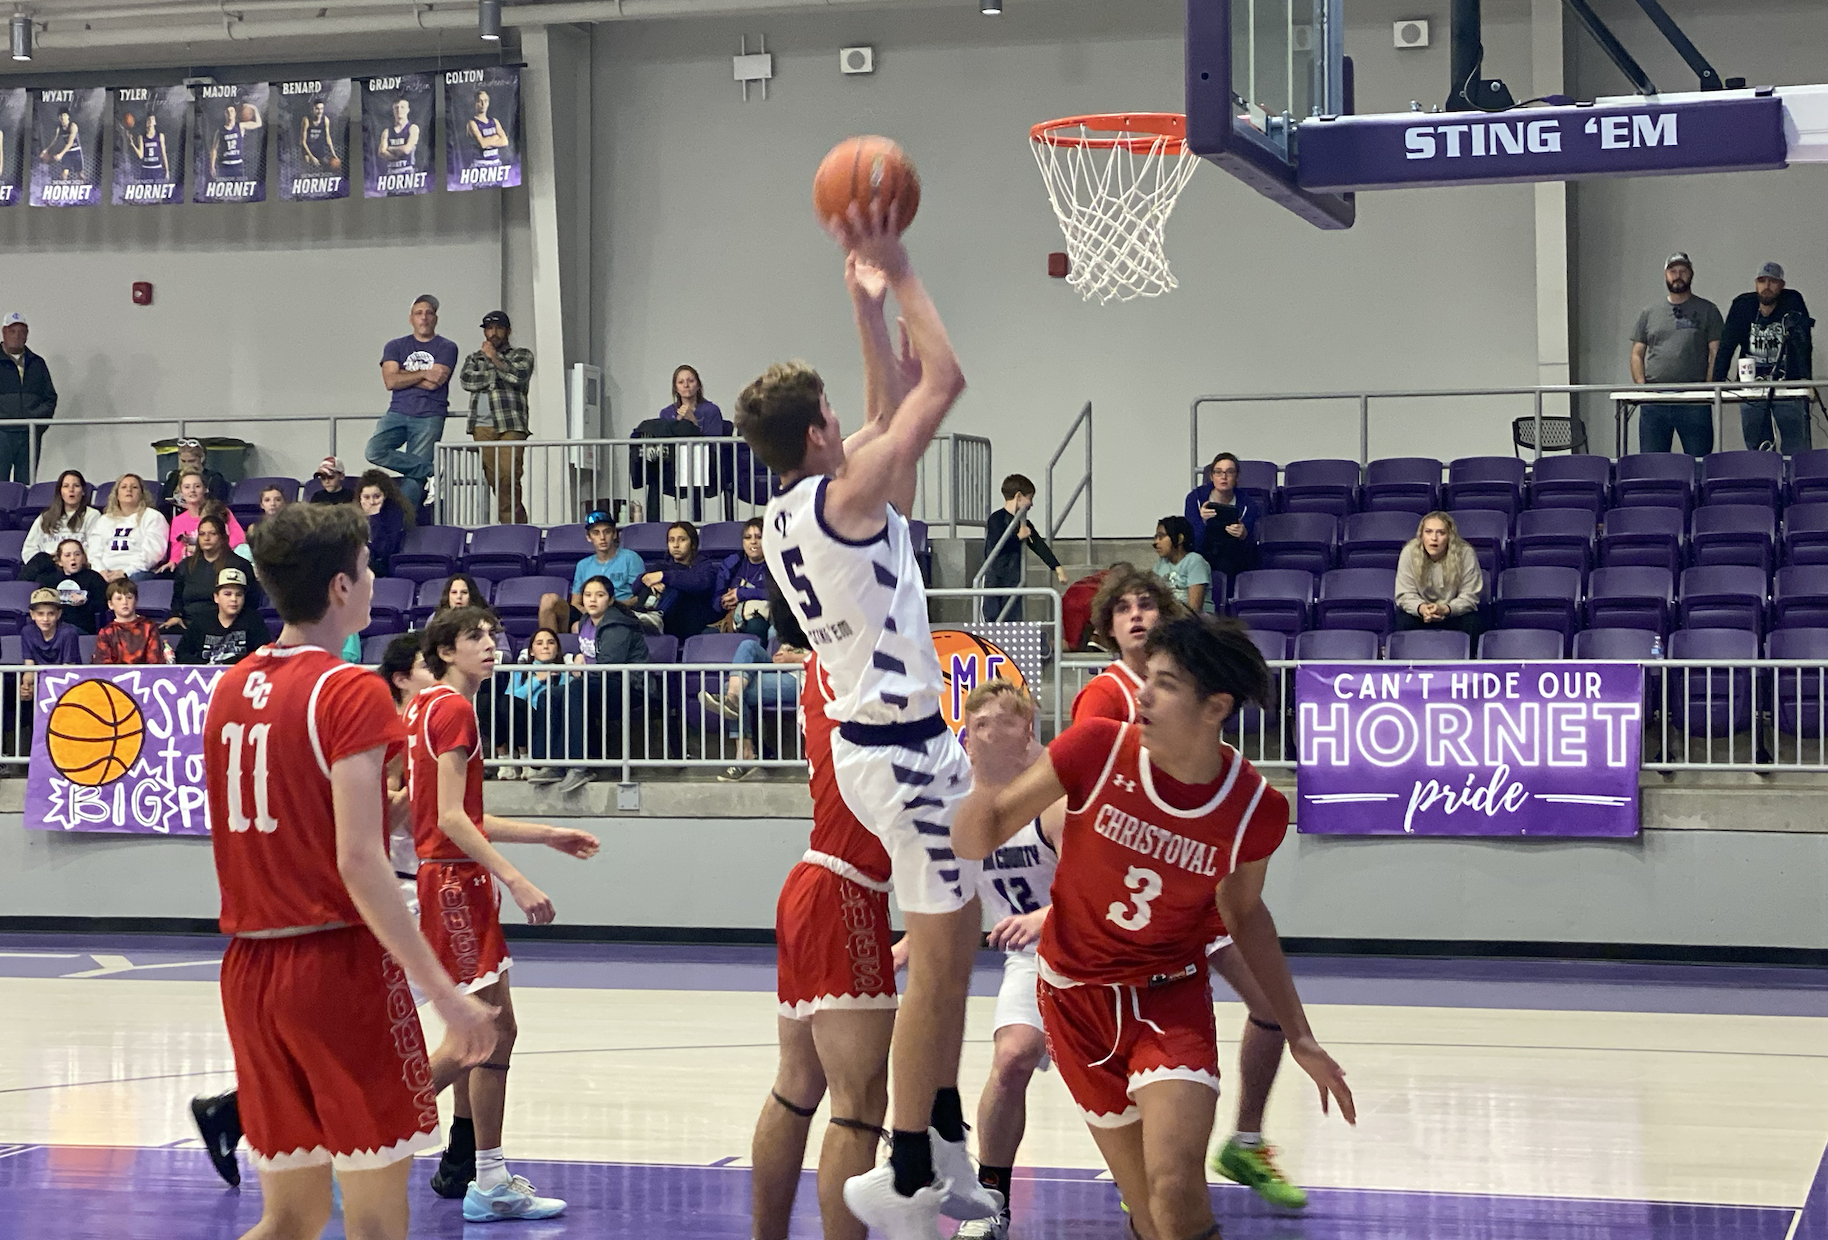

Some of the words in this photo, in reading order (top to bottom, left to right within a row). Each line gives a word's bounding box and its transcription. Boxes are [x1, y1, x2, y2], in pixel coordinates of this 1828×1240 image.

[369, 77, 401, 91] GRADY
[446, 70, 484, 85] COLTON
[42, 90, 74, 102] WYATT
[120, 89, 147, 101] TYLER
[202, 86, 237, 98] MAJOR
[283, 81, 322, 95] BENARD
[1404, 120, 1562, 161] STING
[377, 172, 428, 190] HORNET
[460, 165, 511, 184] HORNET
[42, 185, 92, 200] HORNET
[125, 184, 176, 199] HORNET
[206, 181, 257, 197] HORNET
[292, 177, 342, 194] HORNET
[781, 547, 823, 620] 5
[1451, 671, 1520, 699] HIDE
[1539, 671, 1603, 699] OUR
[1299, 702, 1641, 767] HORNET
[220, 722, 279, 834] 11
[68, 777, 162, 828] BIG
[1403, 763, 1530, 833] pride
[1093, 803, 1218, 878] CHRISTOVAL
[992, 876, 1041, 914] 12
[1106, 865, 1163, 932] 3
